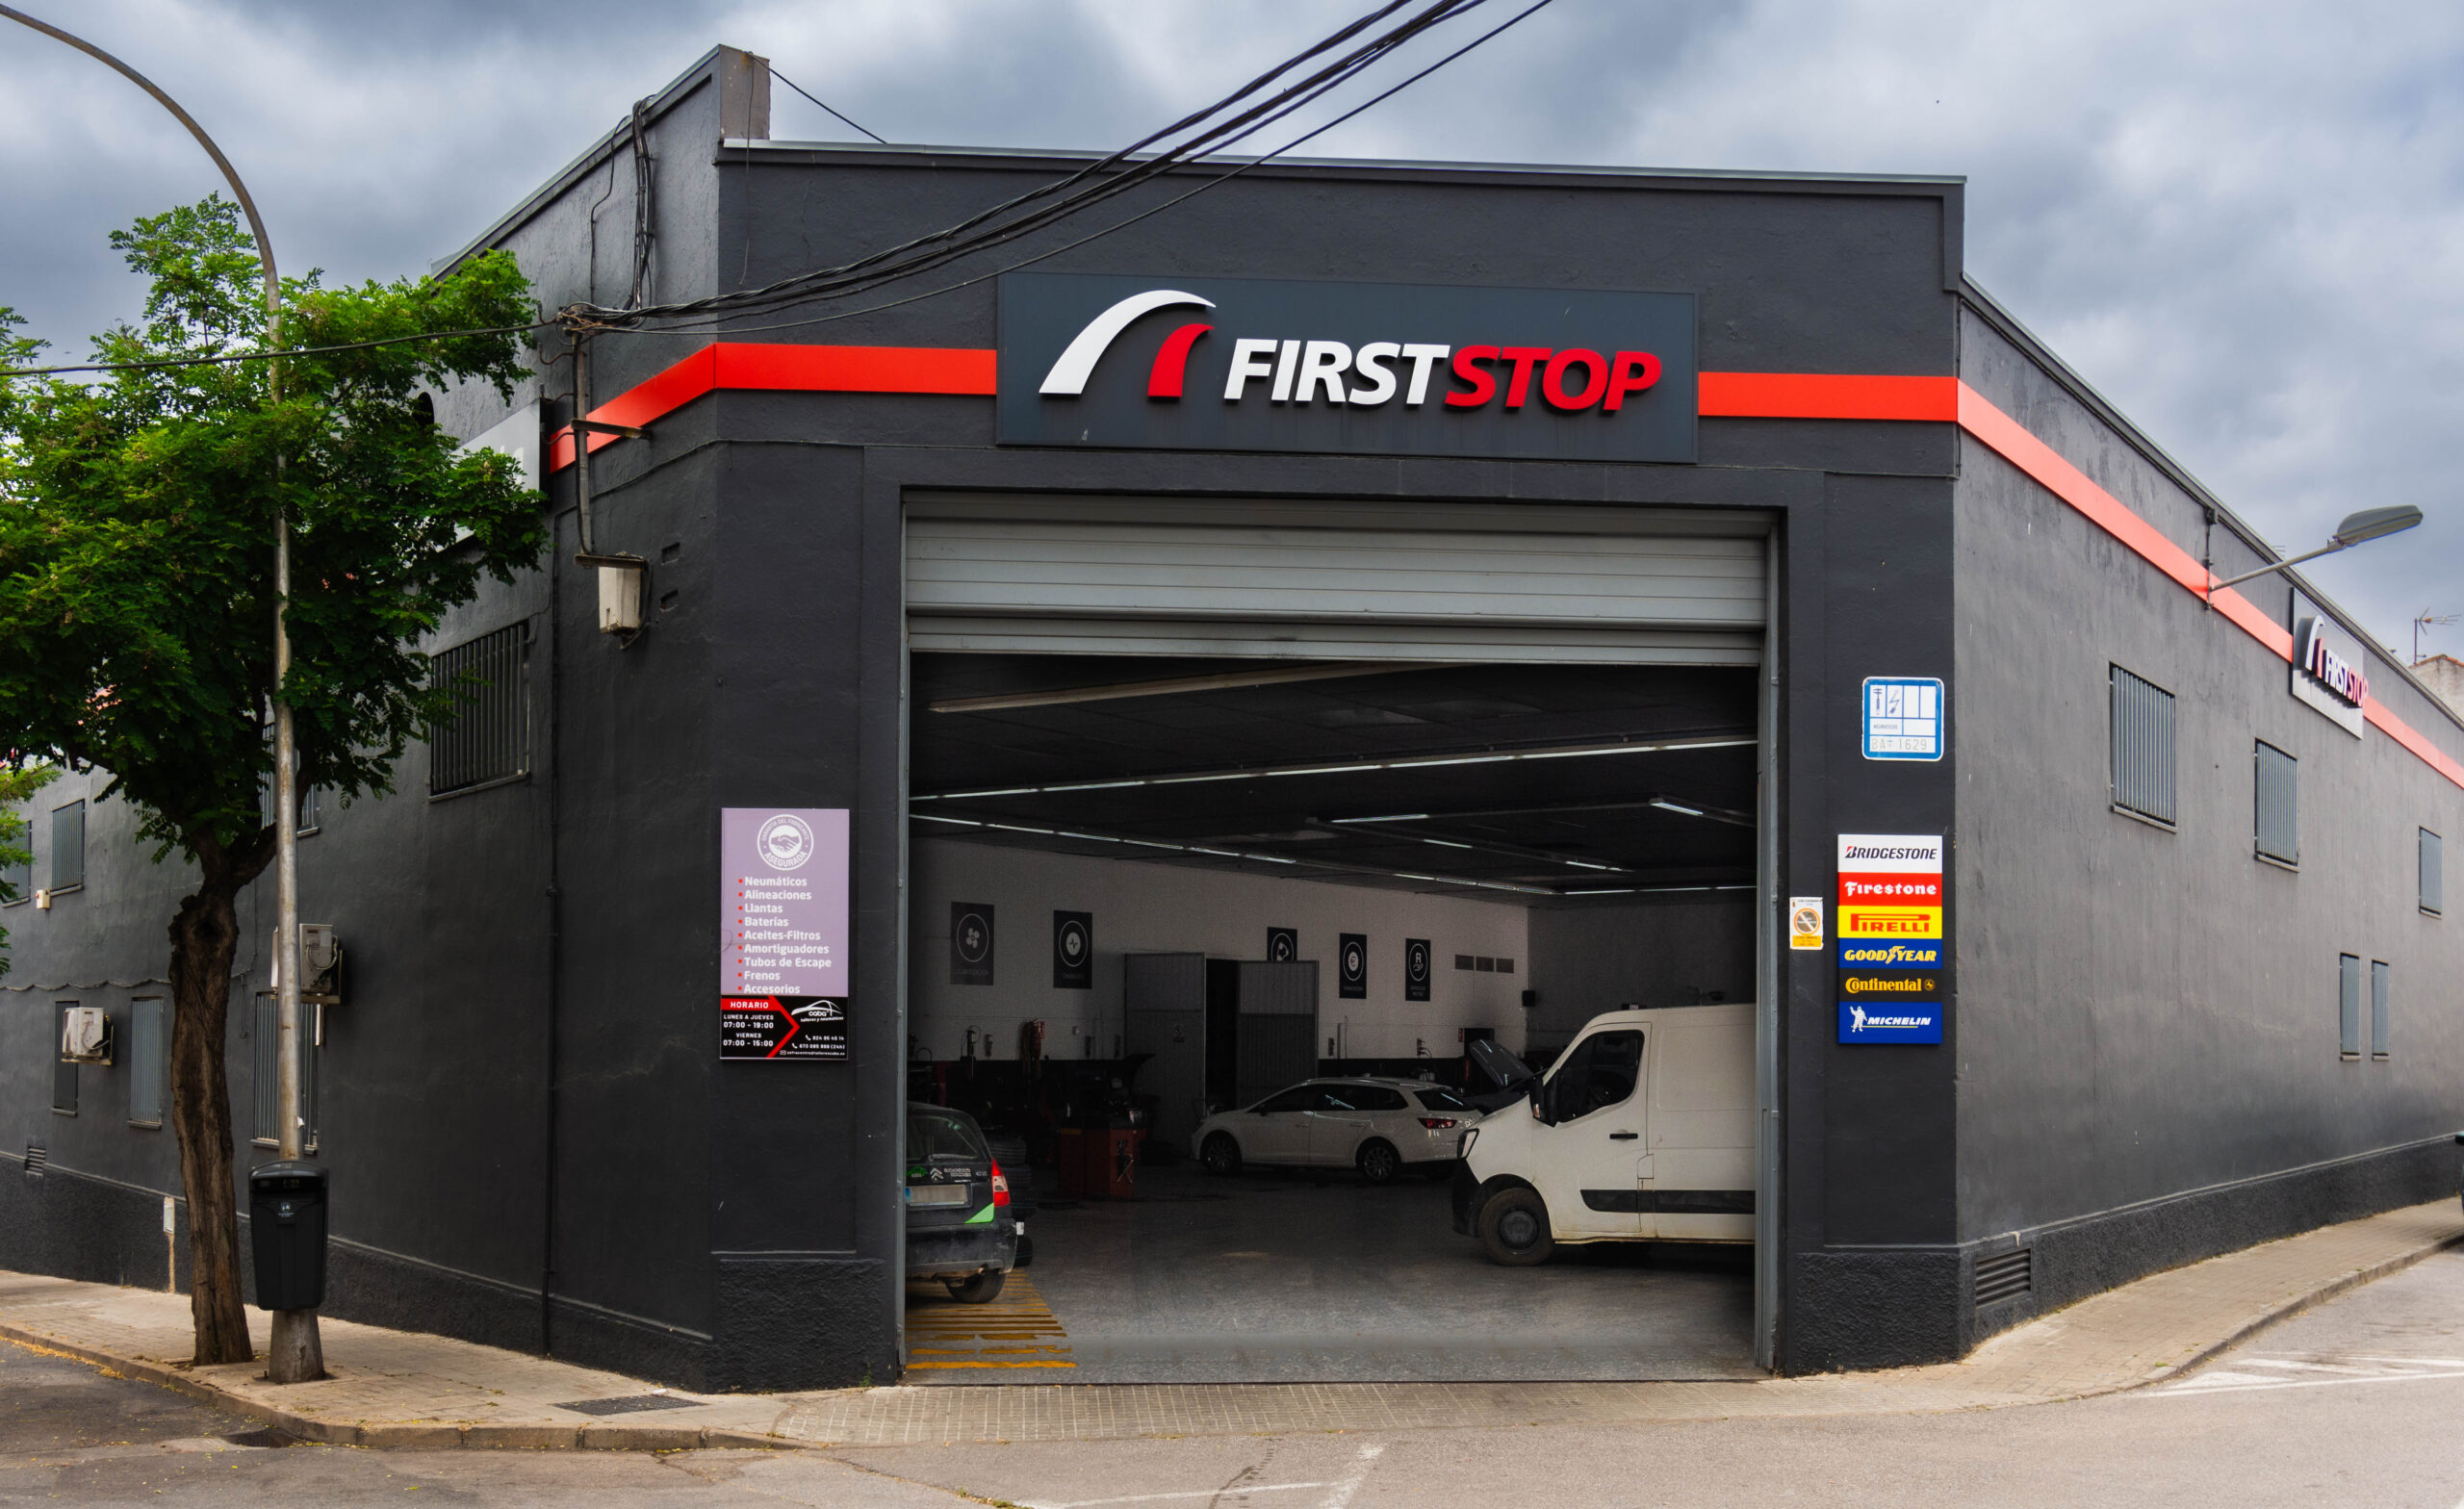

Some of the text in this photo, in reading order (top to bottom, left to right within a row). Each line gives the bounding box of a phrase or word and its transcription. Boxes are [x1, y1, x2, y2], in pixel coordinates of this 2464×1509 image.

[1845, 846, 1938, 859] BRIDGESTONE
[764, 850, 808, 868] ASEGURADA
[744, 876, 808, 886] Neumáticos
[1845, 882, 1937, 897] Firestone
[744, 890, 811, 901] Alineaciones
[744, 904, 783, 913] Llantas
[744, 917, 789, 927] Baterías
[1850, 913, 1931, 932] PIRELLI
[744, 930, 821, 940] Aceites-Filtros
[744, 943, 830, 955] Amortiguadores
[1844, 947, 1937, 963] GOODYEAR
[744, 957, 832, 969] Tubos de Escape
[744, 970, 781, 981] Frenos
[744, 984, 801, 994] Accesorios
[1845, 977, 1922, 993] Continental
[730, 1001, 769, 1010] HORARIO
[1867, 1016, 1932, 1026] MICHELIN
